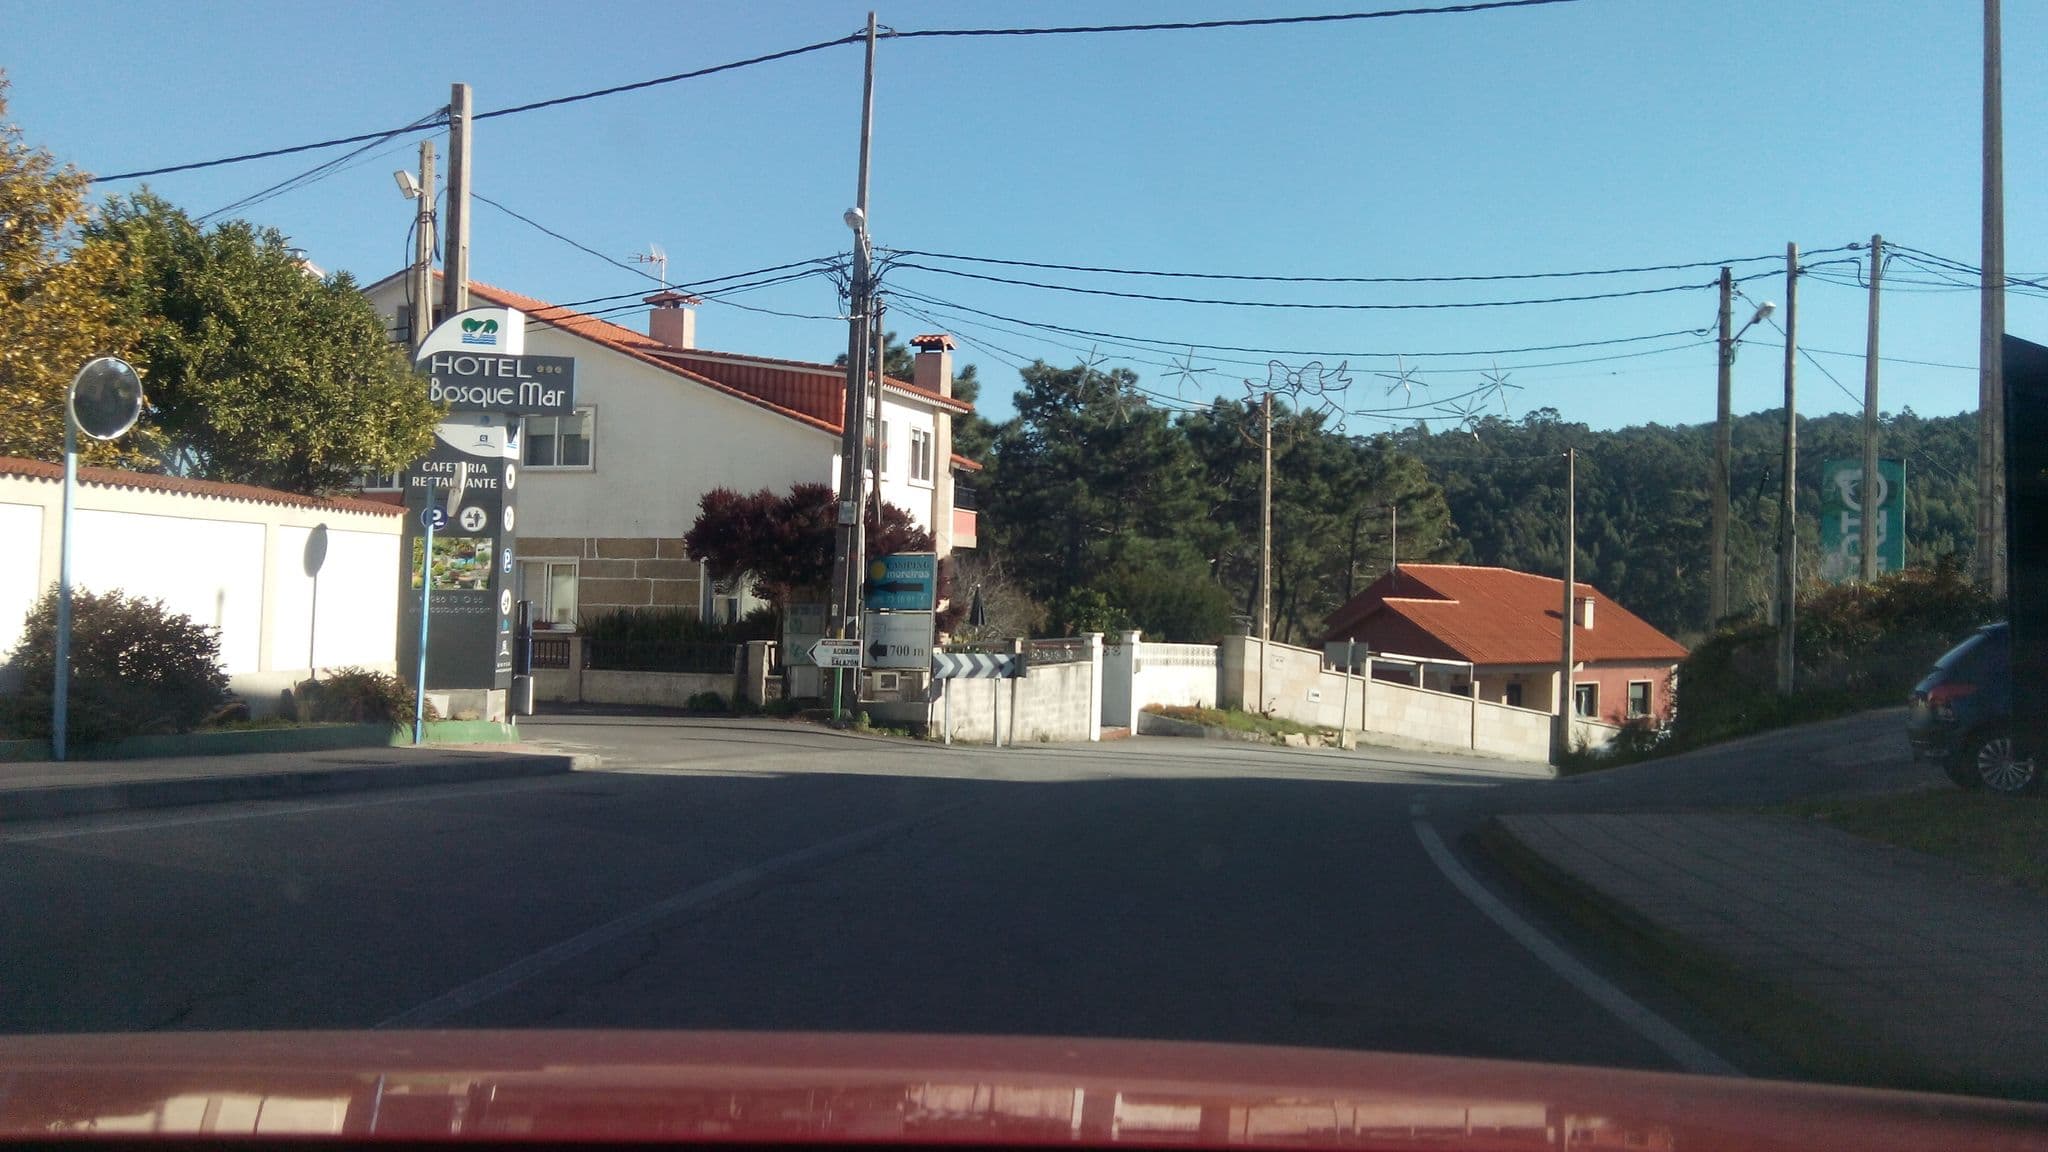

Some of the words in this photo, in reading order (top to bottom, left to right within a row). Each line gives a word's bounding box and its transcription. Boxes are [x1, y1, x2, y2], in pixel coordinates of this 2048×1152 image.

[431, 355, 532, 378] HOTEL
[430, 377, 514, 408] Bosque
[518, 382, 566, 407] Mar
[421, 461, 488, 474] CAFETRIA
[890, 644, 910, 657] 700
[912, 648, 925, 657] m
